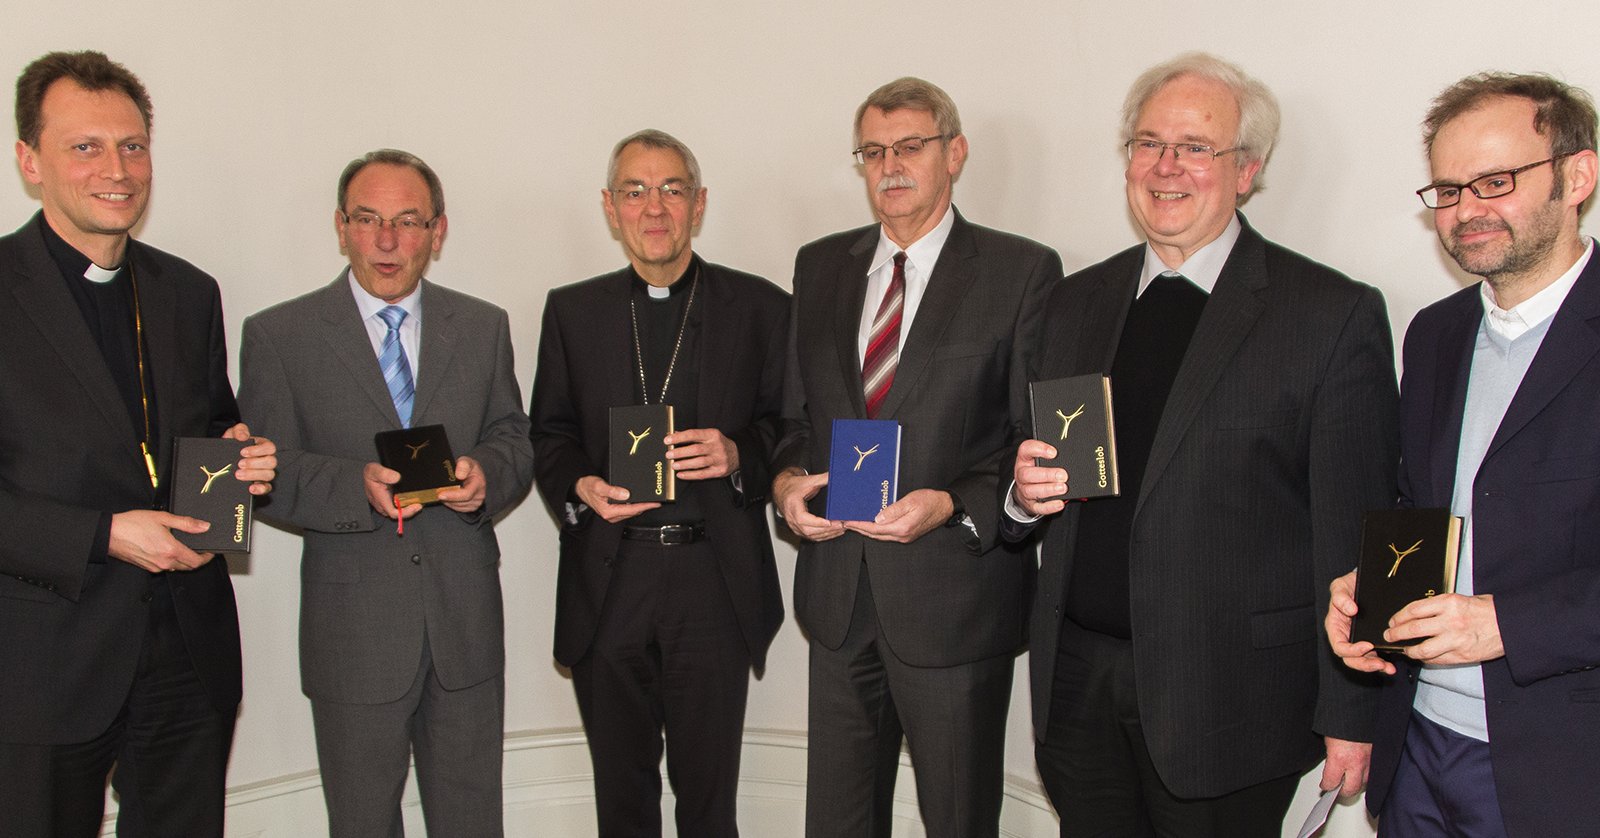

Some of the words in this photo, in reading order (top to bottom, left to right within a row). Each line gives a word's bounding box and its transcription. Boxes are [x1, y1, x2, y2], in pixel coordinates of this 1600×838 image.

[655, 461, 663, 495] Gotteslob
[1095, 446, 1107, 488] Gotteslob
[880, 480, 889, 511] otteslob
[233, 503, 244, 543] Gotteslob
